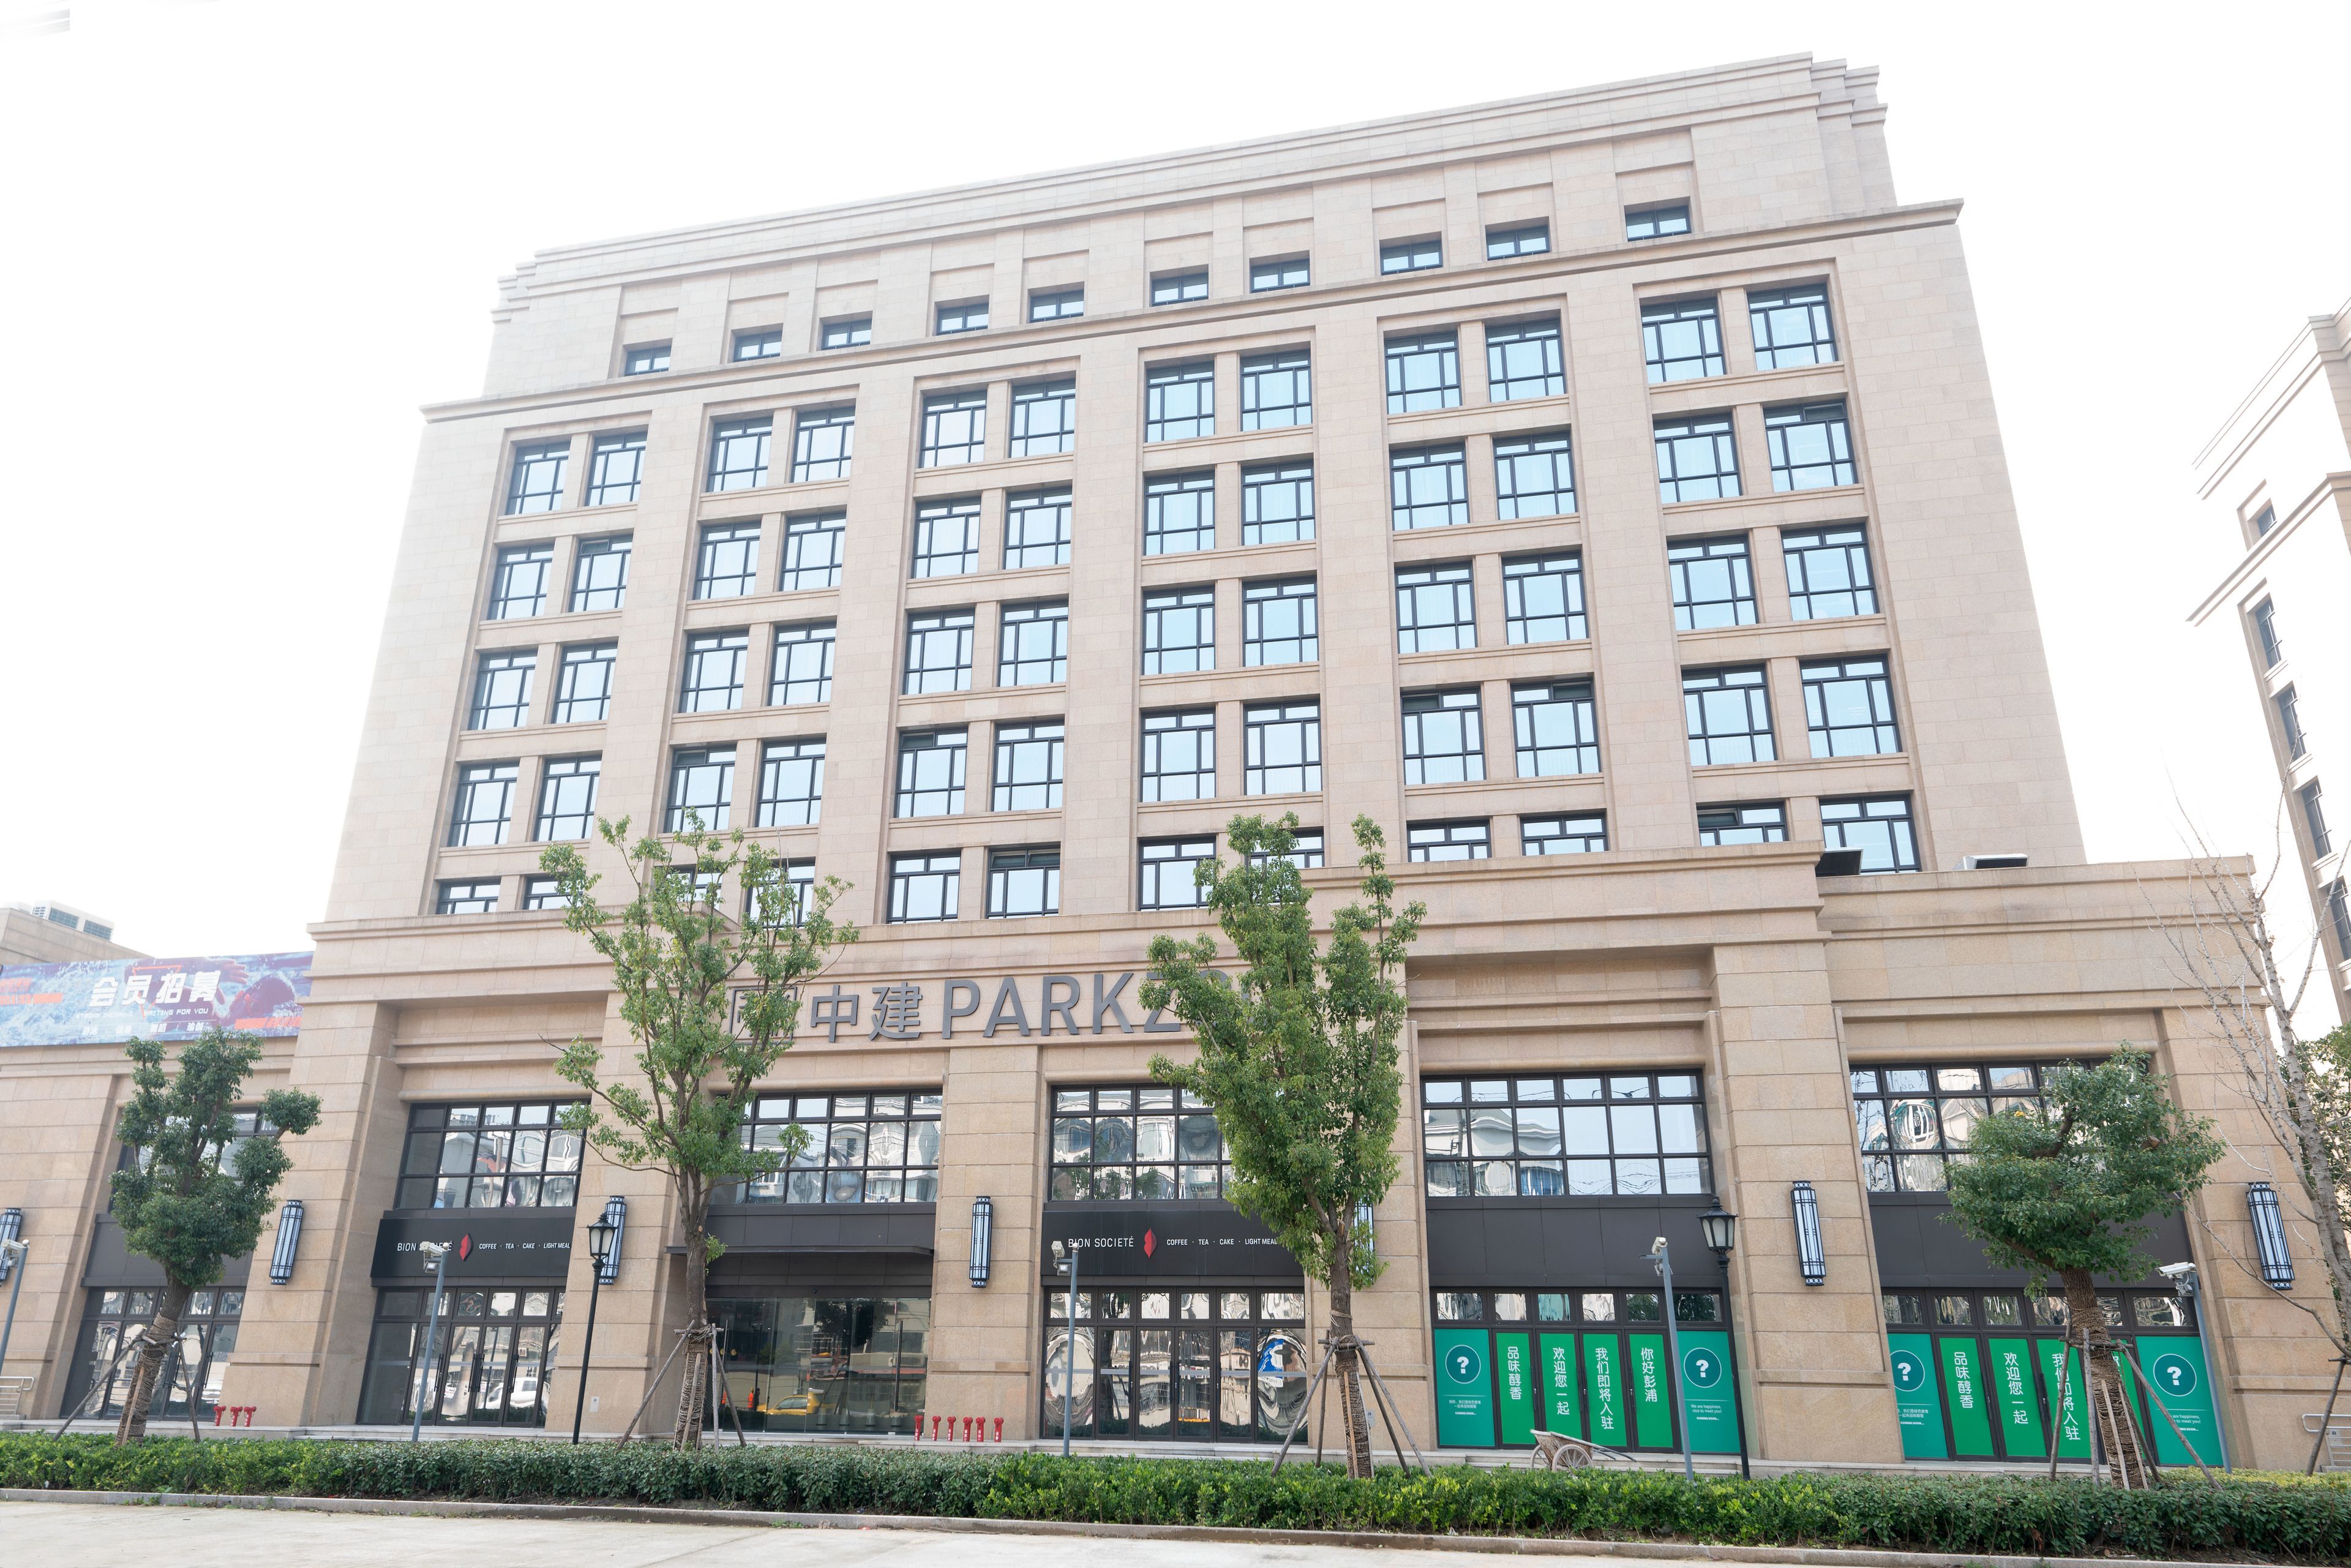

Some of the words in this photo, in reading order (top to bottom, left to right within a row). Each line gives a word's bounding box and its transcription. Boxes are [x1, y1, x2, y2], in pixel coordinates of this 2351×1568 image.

[89, 970, 220, 1007] 会员招募
[811, 982, 923, 1043] 中建
[1068, 1238, 1090, 1247] BION
[1095, 1236, 1134, 1247] SOCIETÉ
[1457, 1356, 1469, 1374] ?
[1507, 1346, 1522, 1400] 品味醇香
[1553, 1347, 1570, 1415] 欢迎您一起
[1595, 1347, 1614, 1430] 我们即将入驻
[1641, 1347, 1657, 1402] 你好彭浦
[1696, 1359, 1709, 1378] ?
[1897, 1362, 1911, 1381] ?
[1954, 1352, 1973, 1408] 品味醇香
[2003, 1352, 2028, 1424] 欢迎您一起
[2167, 1366, 2181, 1386] ?
